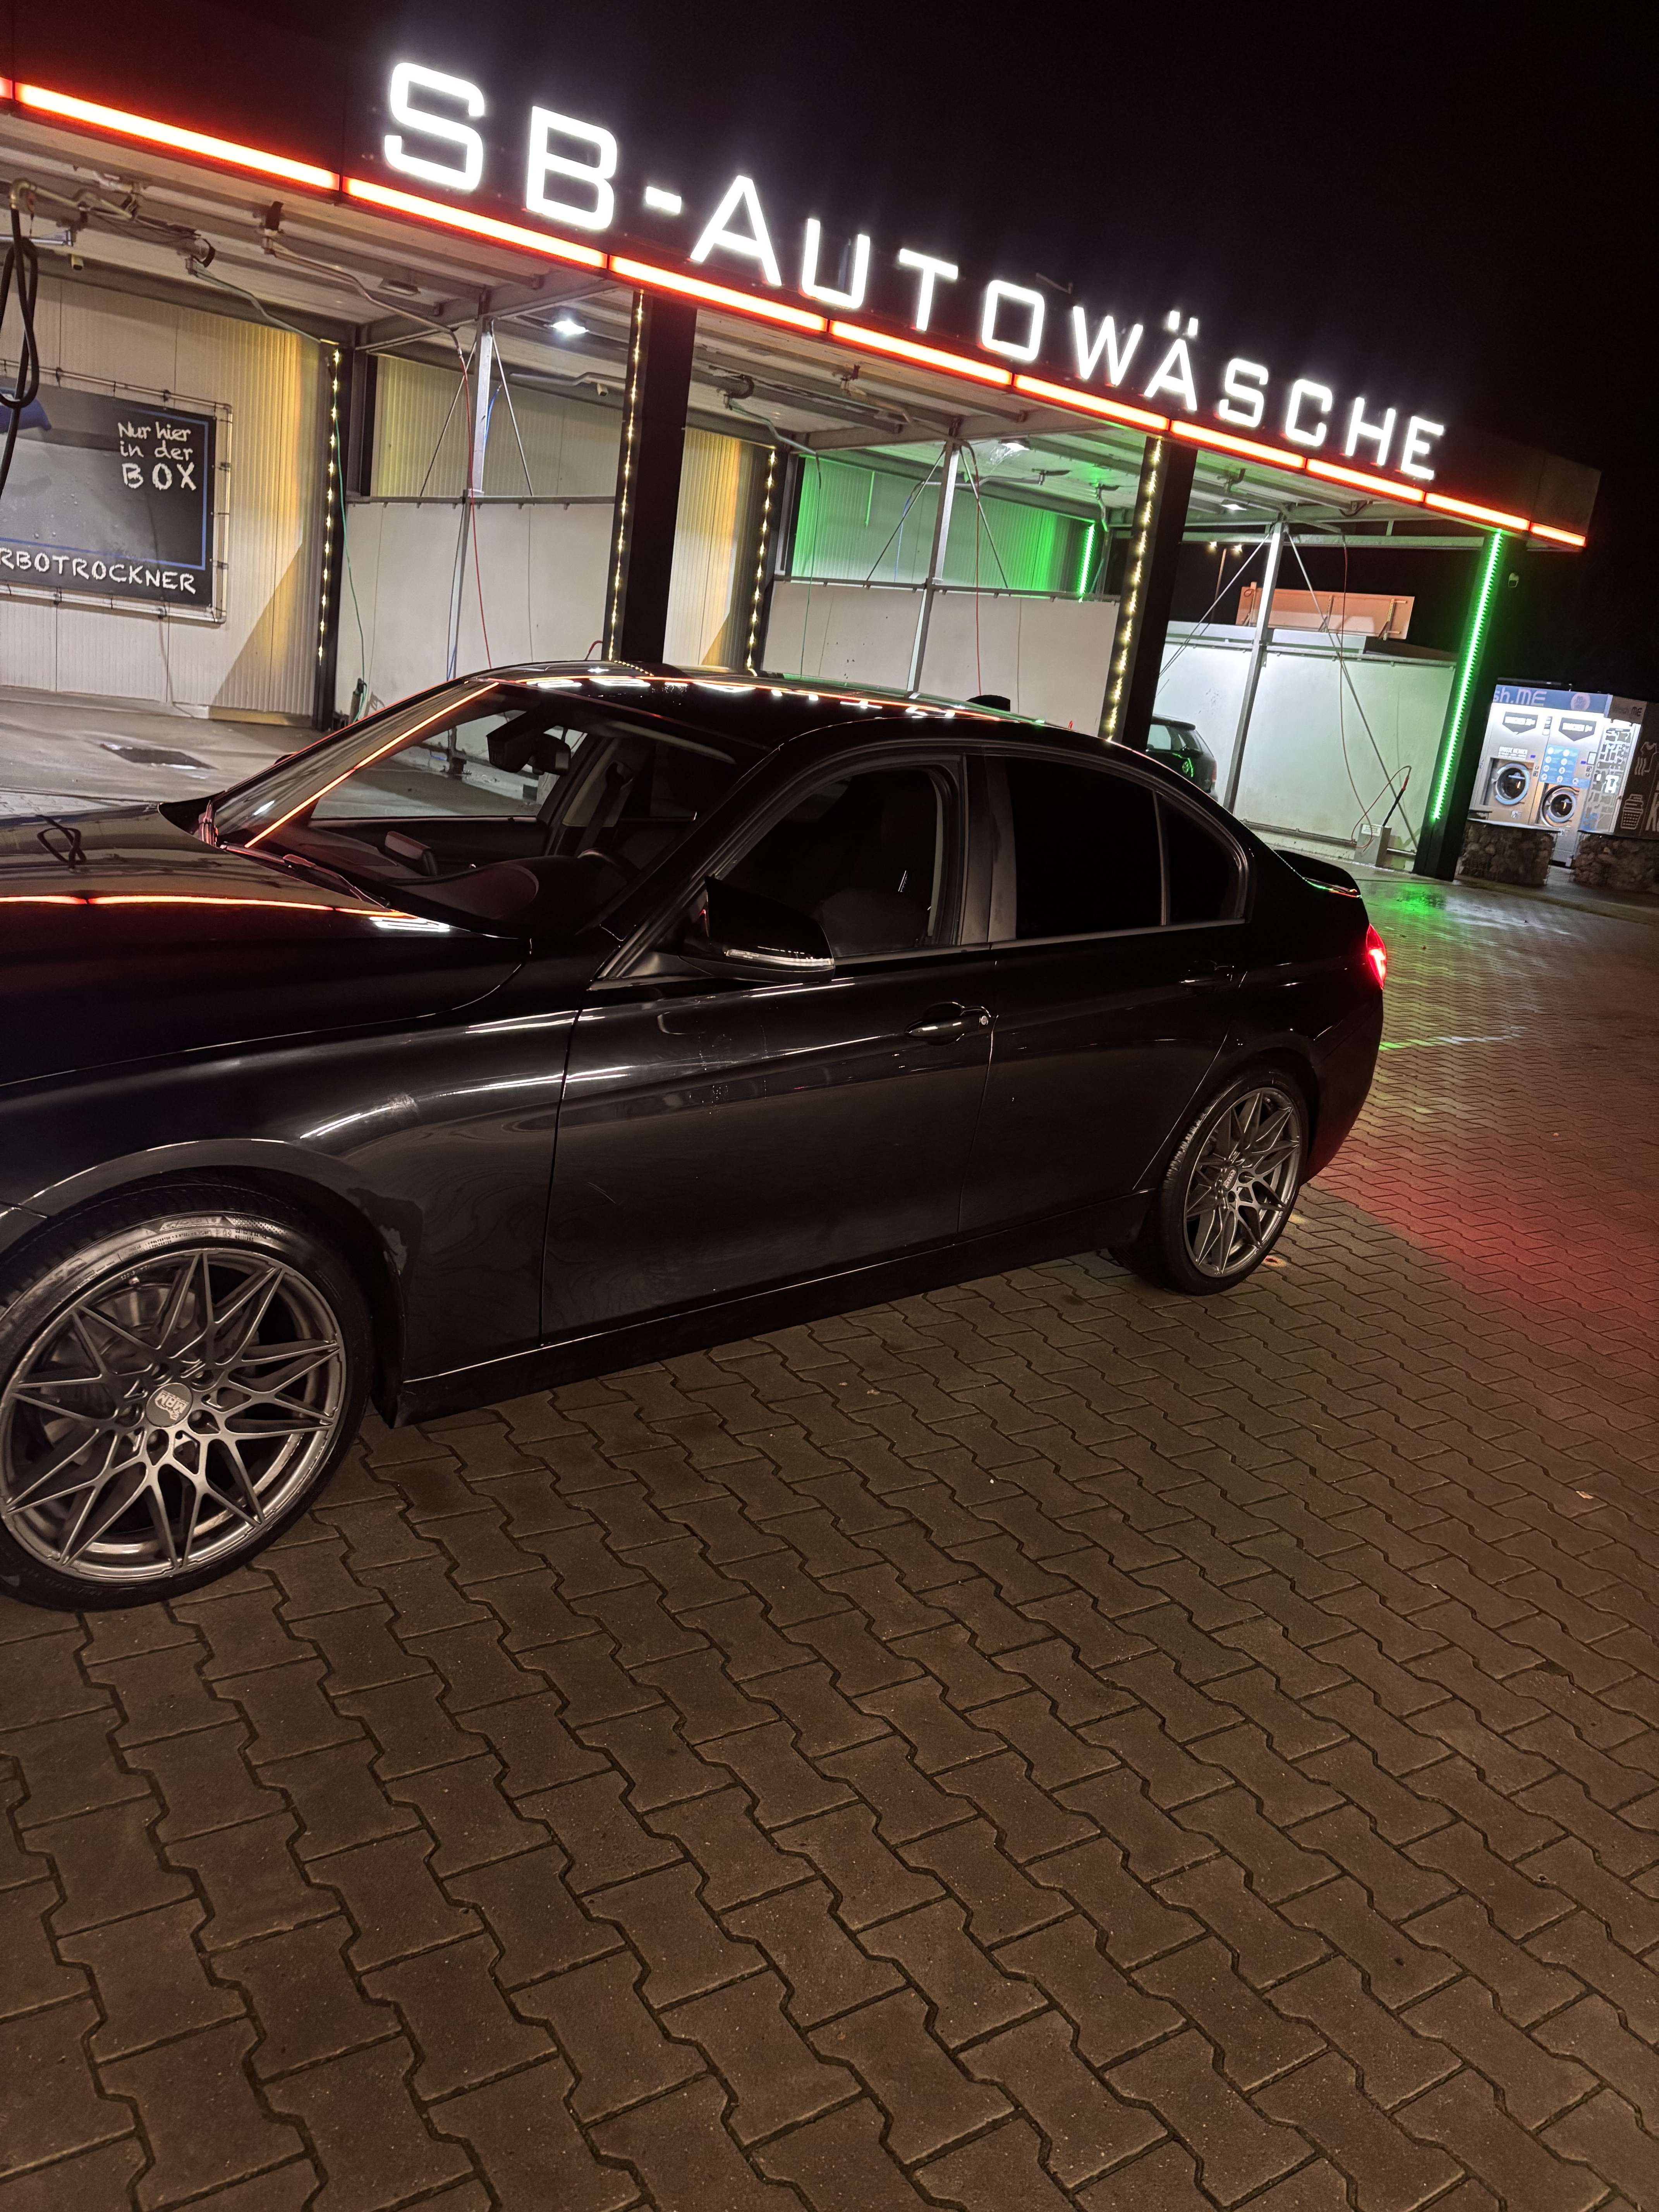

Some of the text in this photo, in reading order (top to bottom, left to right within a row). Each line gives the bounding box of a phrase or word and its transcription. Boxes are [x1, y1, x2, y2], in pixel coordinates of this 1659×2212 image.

[118, 421, 191, 441] Nur hier
[120, 440, 193, 461] in der
[122, 462, 197, 491] BOX
